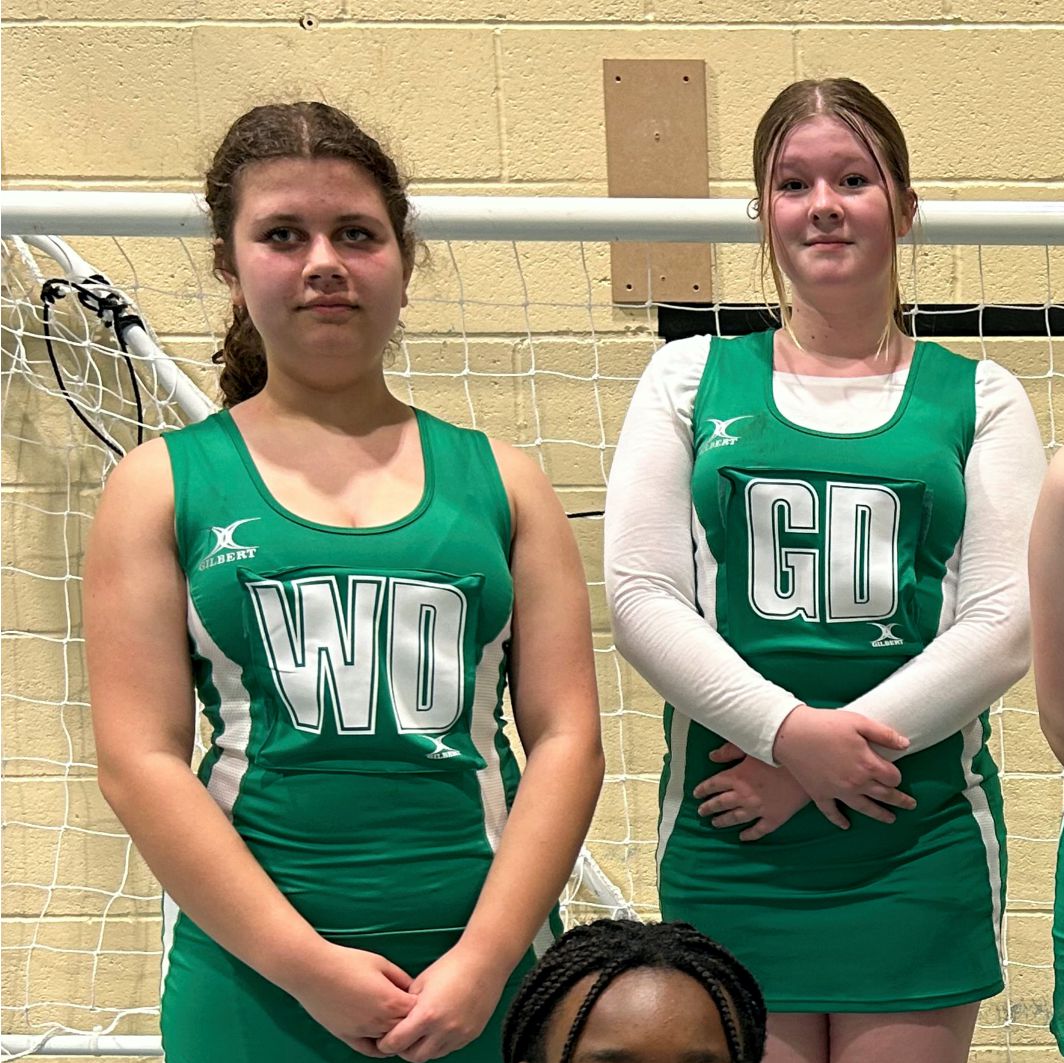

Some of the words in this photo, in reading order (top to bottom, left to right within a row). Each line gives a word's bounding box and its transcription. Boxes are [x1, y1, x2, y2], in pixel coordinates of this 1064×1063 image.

[199, 548, 257, 571] GILBERT
[744, 478, 901, 624] GD
[245, 574, 468, 735] WD
